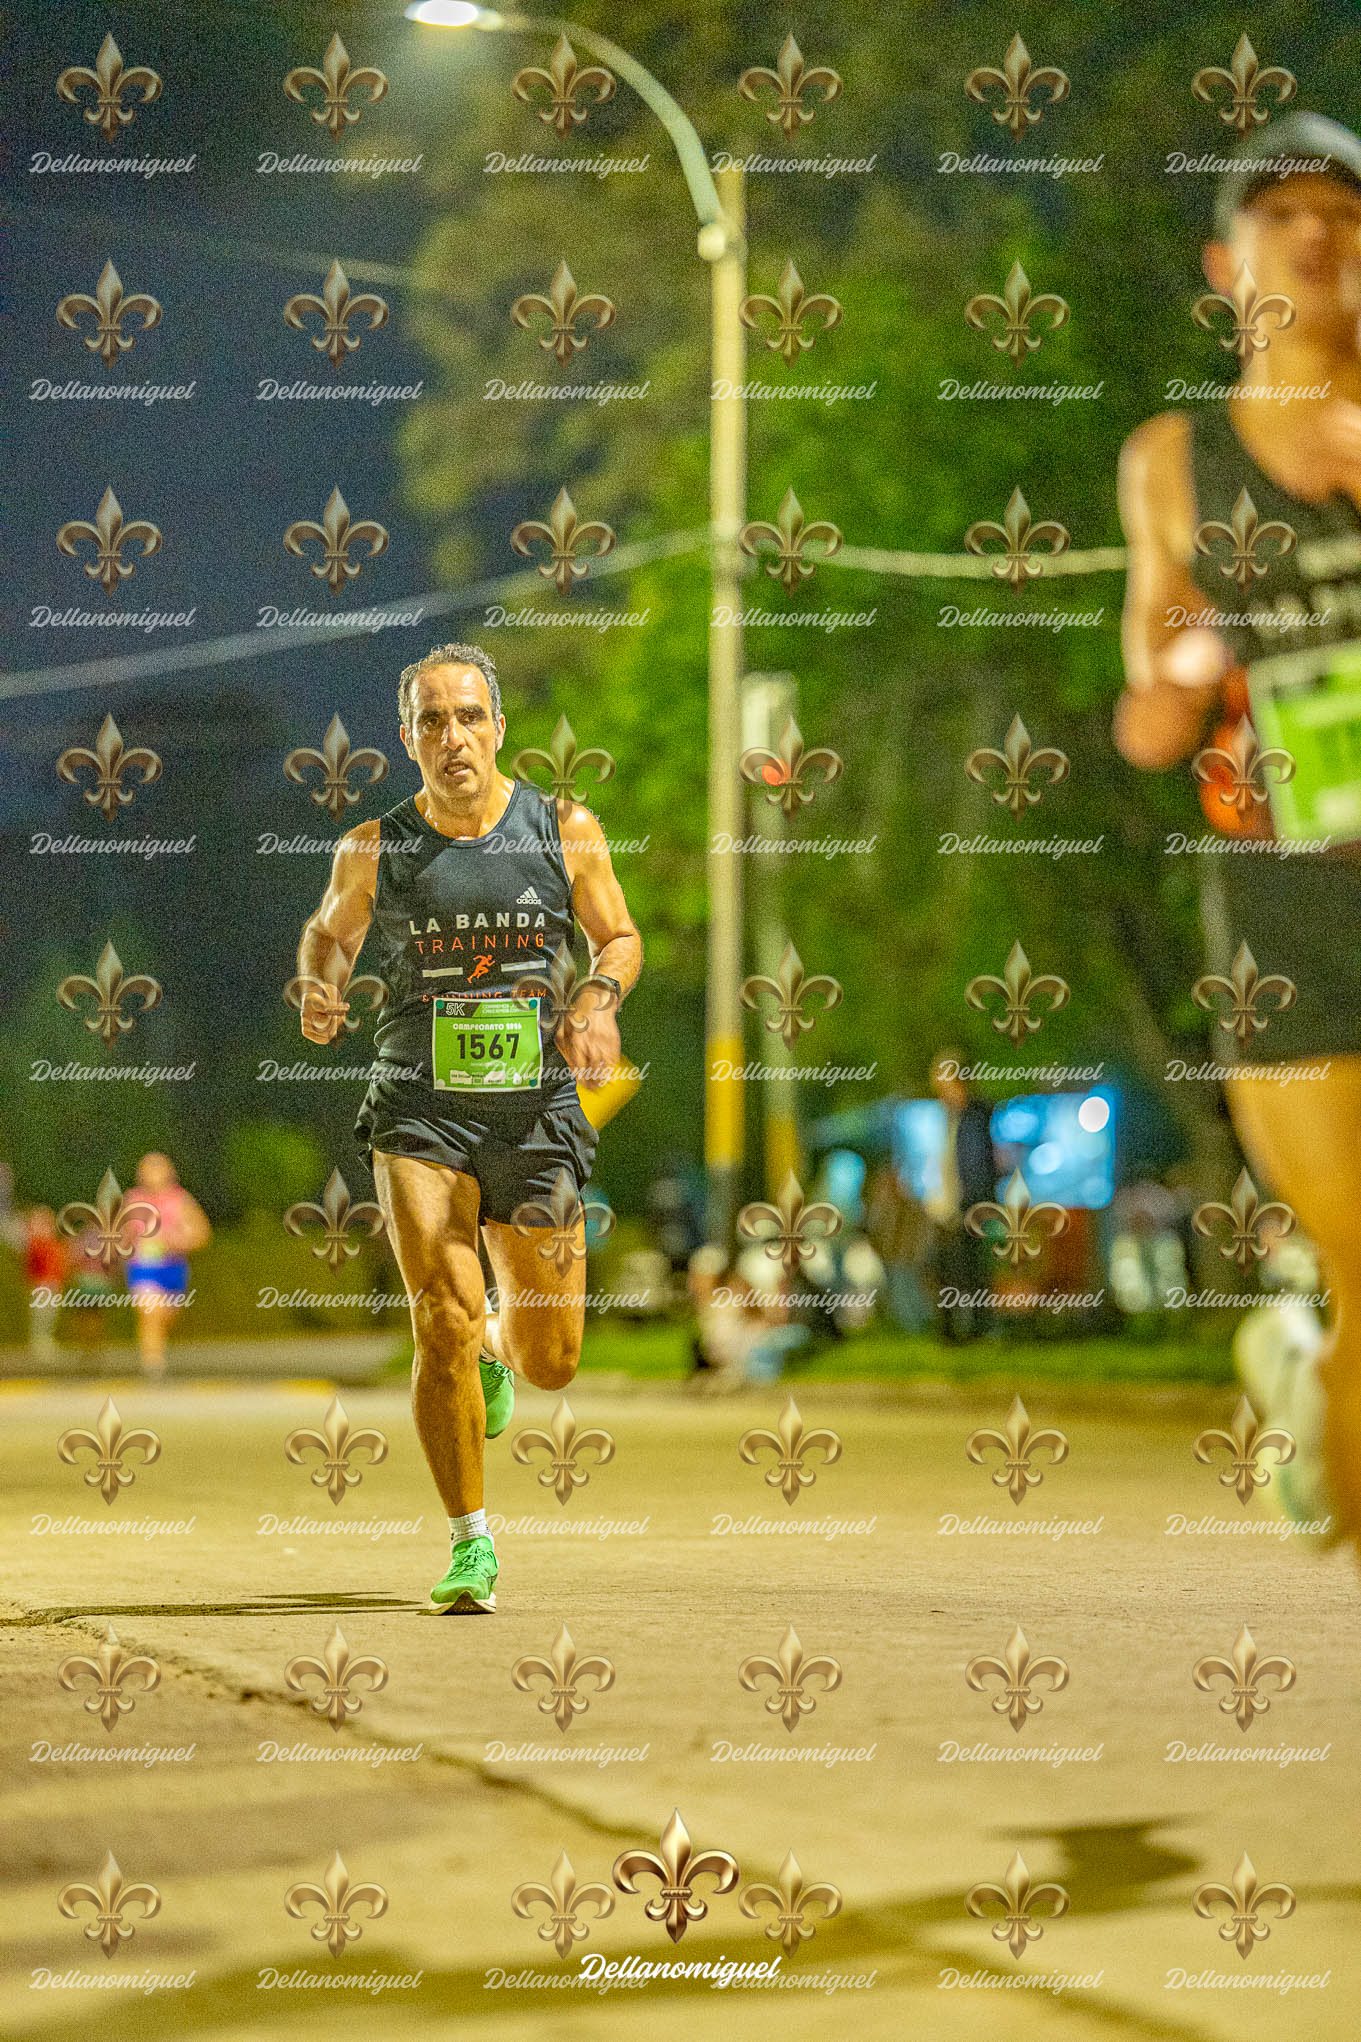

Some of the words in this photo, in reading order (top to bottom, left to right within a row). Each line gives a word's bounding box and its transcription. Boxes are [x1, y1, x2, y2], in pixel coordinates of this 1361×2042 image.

[409, 918, 441, 935] LA
[456, 912, 546, 929] BANDA
[414, 933, 545, 955] TRAINING
[446, 1002, 465, 1016] 5K
[457, 1033, 519, 1060] 1567
